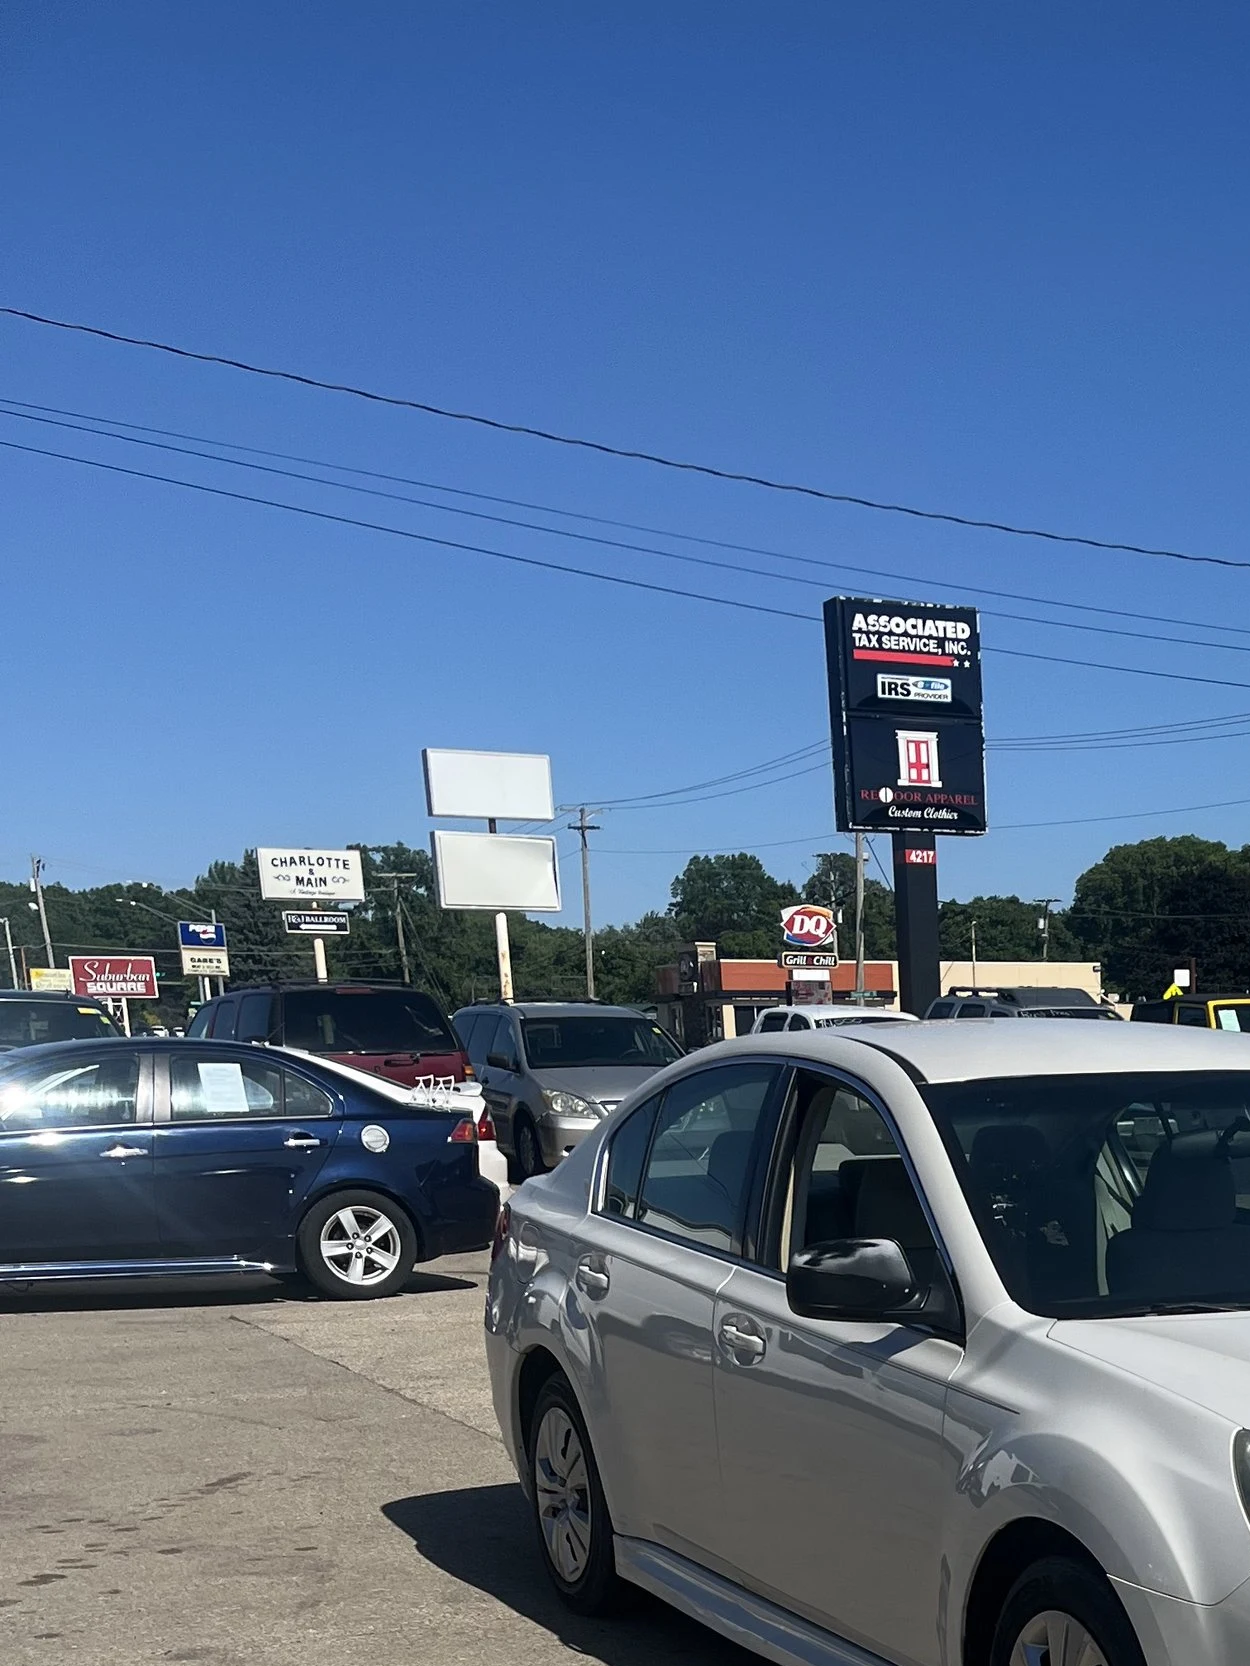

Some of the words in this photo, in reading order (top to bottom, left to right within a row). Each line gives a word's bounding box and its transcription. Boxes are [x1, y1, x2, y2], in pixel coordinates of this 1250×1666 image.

[851, 613, 971, 639] ASSOCIATED
[852, 633, 879, 648] TAX
[882, 635, 942, 655] SERVICE,
[945, 641, 971, 655] INC.
[881, 680, 911, 697] IRS
[914, 692, 949, 700] PROVIDER
[926, 794, 979, 806] APPAREL
[888, 805, 922, 818] Custom
[924, 807, 959, 820] Clothier
[909, 850, 935, 863] 4217
[271, 856, 351, 871] CHARLOTTE
[308, 868, 315, 876] &
[295, 876, 328, 888] MAIN
[305, 915, 346, 924] BALLROOM
[791, 914, 826, 938] DQ
[785, 955, 807, 965] Grill
[813, 956, 835, 966] Chill
[79, 961, 150, 982] Suburban
[86, 981, 146, 994] SQUARE
